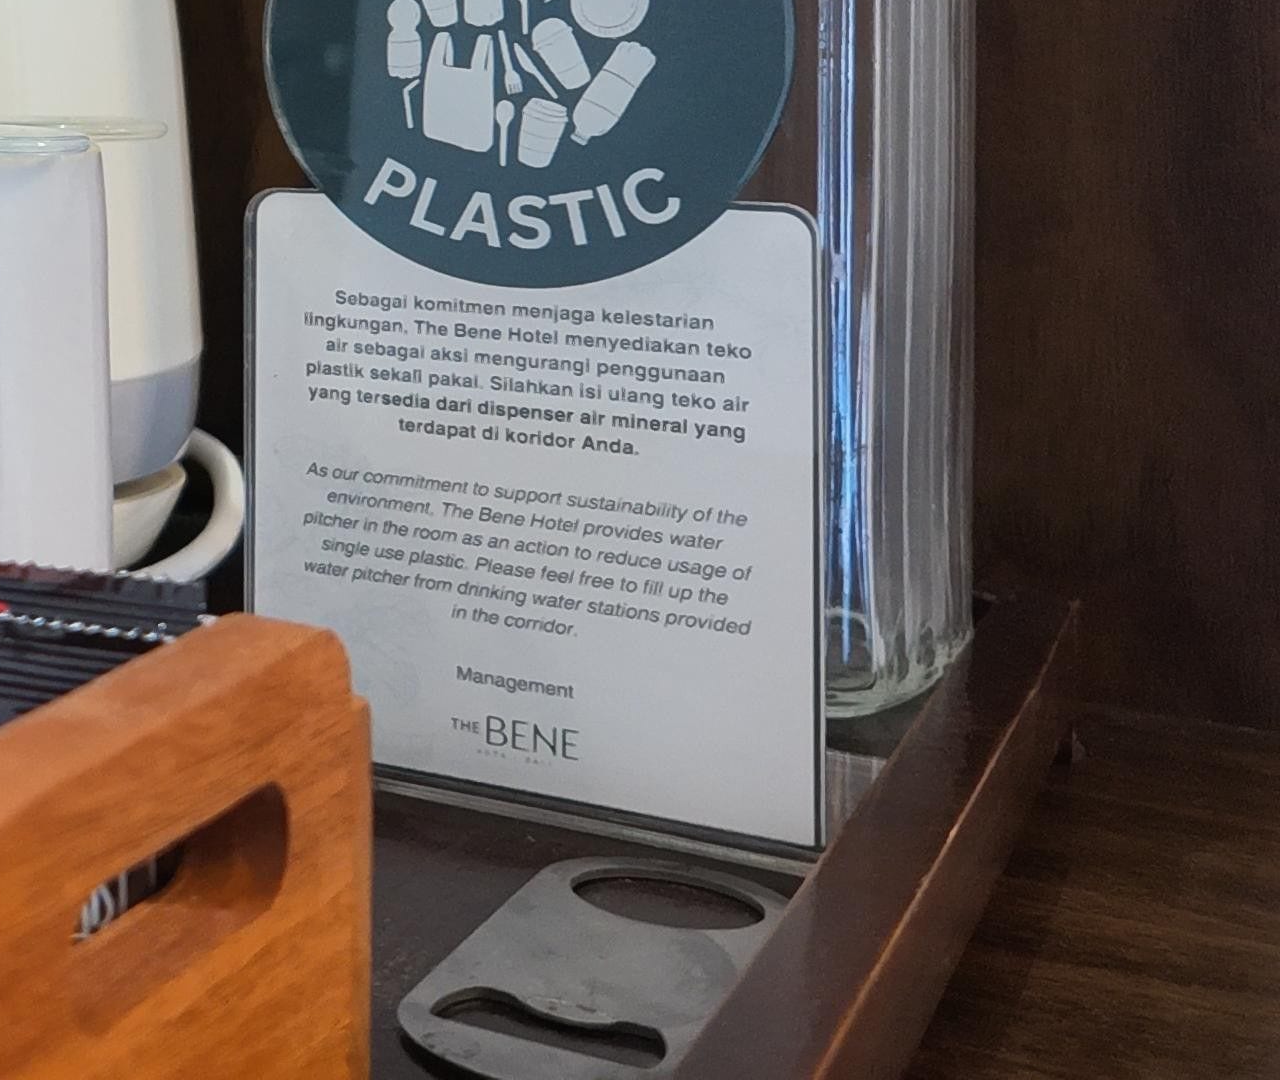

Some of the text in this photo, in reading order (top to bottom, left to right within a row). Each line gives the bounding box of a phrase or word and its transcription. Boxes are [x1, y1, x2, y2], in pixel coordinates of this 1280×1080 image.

[363, 157, 681, 249] PLASTIC
[335, 289, 714, 330] Sebagai komitmen menjaga kelestarian
[326, 335, 725, 383] air sebagai aksi mengurangi penggunaan
[413, 318, 448, 335] The
[454, 321, 504, 339] Bene
[508, 326, 558, 344] Hotel
[564, 333, 700, 355] menyediakan
[706, 341, 752, 358] teko
[306, 359, 365, 377] plastik
[368, 365, 423, 383] sekali
[489, 374, 573, 397] Silahkan
[579, 381, 602, 399] isi
[607, 385, 664, 408] ulang
[671, 391, 716, 409] teko
[723, 394, 750, 411] air
[308, 385, 745, 442] yang tersedia dari dispenser air mineral yang
[398, 416, 640, 455] terdapat di koridor Anda.
[305, 461, 748, 526] As our commitment to support sustainability of the
[302, 509, 753, 580] pitcher in the room as an action to reduce usage of
[443, 500, 475, 519] The
[478, 505, 529, 526] Bene
[529, 512, 579, 534] Hotel
[582, 521, 664, 542] provides
[668, 532, 724, 549] water
[321, 536, 370, 557] single
[374, 545, 408, 560] use
[474, 555, 536, 578] Please
[540, 564, 575, 583] feel
[578, 569, 615, 589] free
[617, 575, 638, 592] to
[642, 578, 664, 596] fill
[668, 584, 693, 603] up
[697, 586, 729, 604] the
[304, 560, 752, 634] water pitcher from drinking water stations provided
[451, 602, 577, 636] in the corridor.
[456, 664, 574, 698] Management
[451, 715, 579, 761] THE BENE
